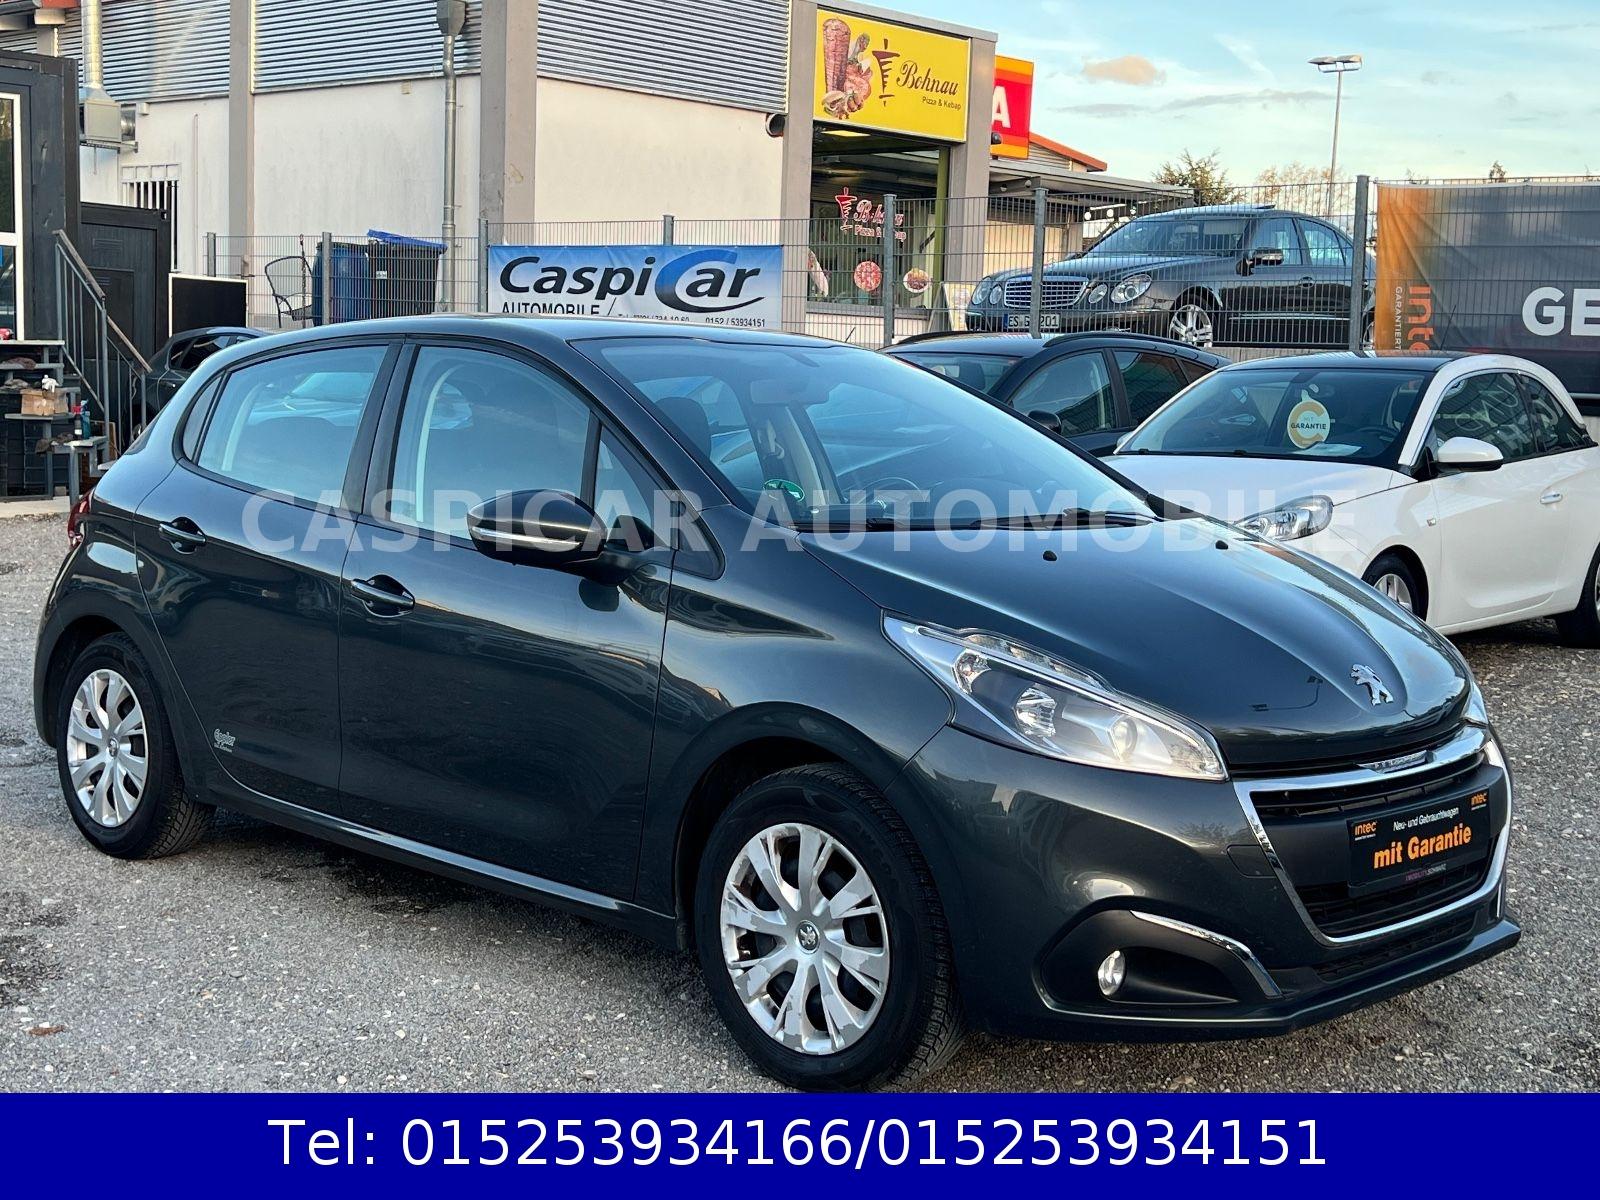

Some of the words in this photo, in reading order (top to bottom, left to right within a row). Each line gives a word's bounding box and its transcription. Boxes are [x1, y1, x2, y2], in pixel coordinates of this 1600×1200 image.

[896, 60, 958, 96] Bohnau
[922, 96, 937, 107] Pizza
[938, 98, 943, 107] &
[943, 99, 962, 111] Kebap
[500, 249, 766, 314] CaspiCar
[1290, 422, 1327, 430] GARANTIE
[1354, 821, 1377, 835] intec
[1407, 815, 1418, 827] und
[1373, 841, 1402, 869] mit
[1407, 822, 1472, 860] Garantie
